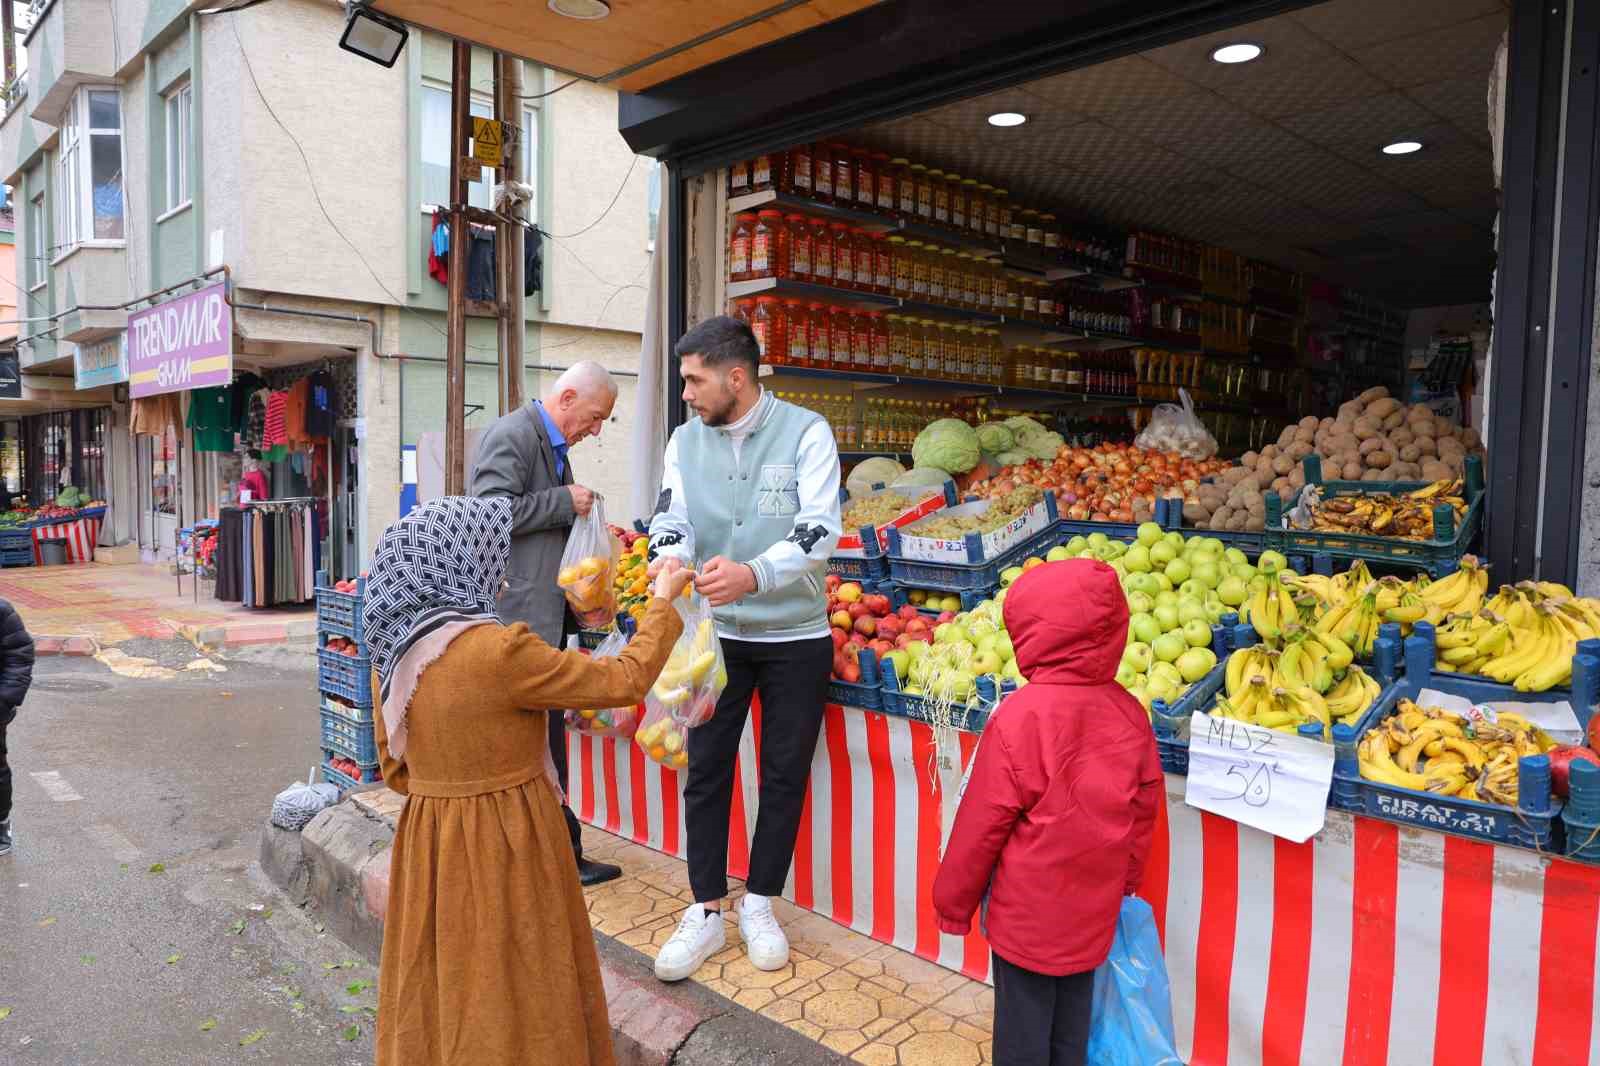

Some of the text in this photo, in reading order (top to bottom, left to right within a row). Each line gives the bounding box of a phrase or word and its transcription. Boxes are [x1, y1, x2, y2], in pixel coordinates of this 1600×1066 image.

[1376, 794, 1497, 827] FIRAT 21
[1451, 818, 1470, 829] 70
[1473, 823, 1491, 834] 21
